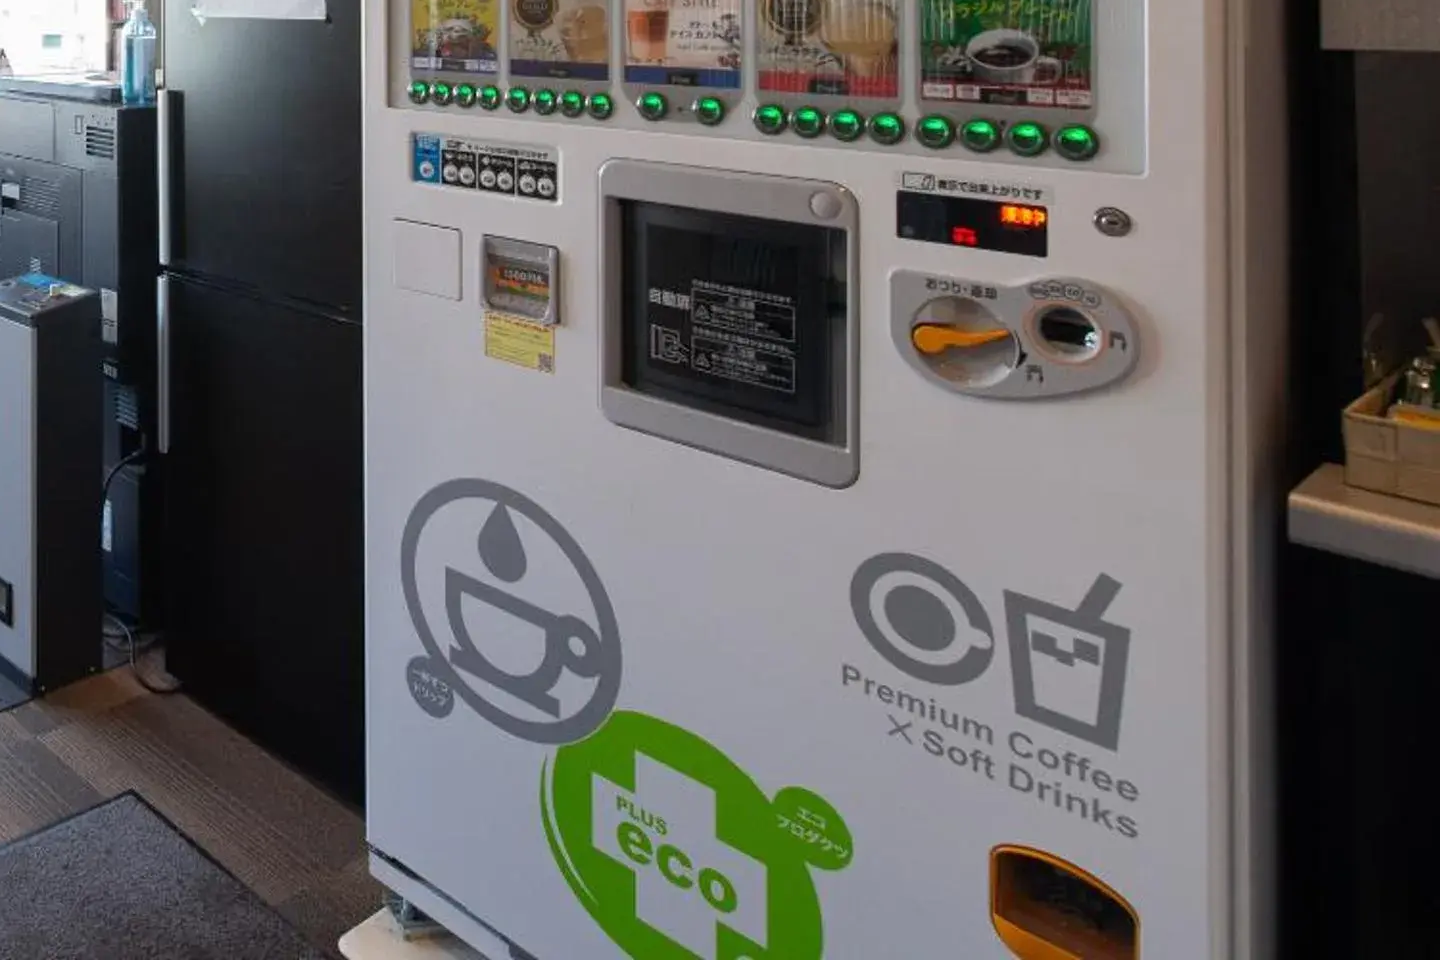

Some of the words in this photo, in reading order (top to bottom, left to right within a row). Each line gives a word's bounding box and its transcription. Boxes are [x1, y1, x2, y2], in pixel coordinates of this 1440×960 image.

[937, 179, 1044, 201] 表示で出来上がりです
[841, 664, 995, 746] Premium
[1007, 731, 1140, 803] Coffee
[616, 795, 668, 836] PLUS
[796, 806, 827, 830] エコ
[922, 729, 996, 781] Soft
[1007, 764, 1139, 840] Drinks
[616, 821, 738, 914] eco
